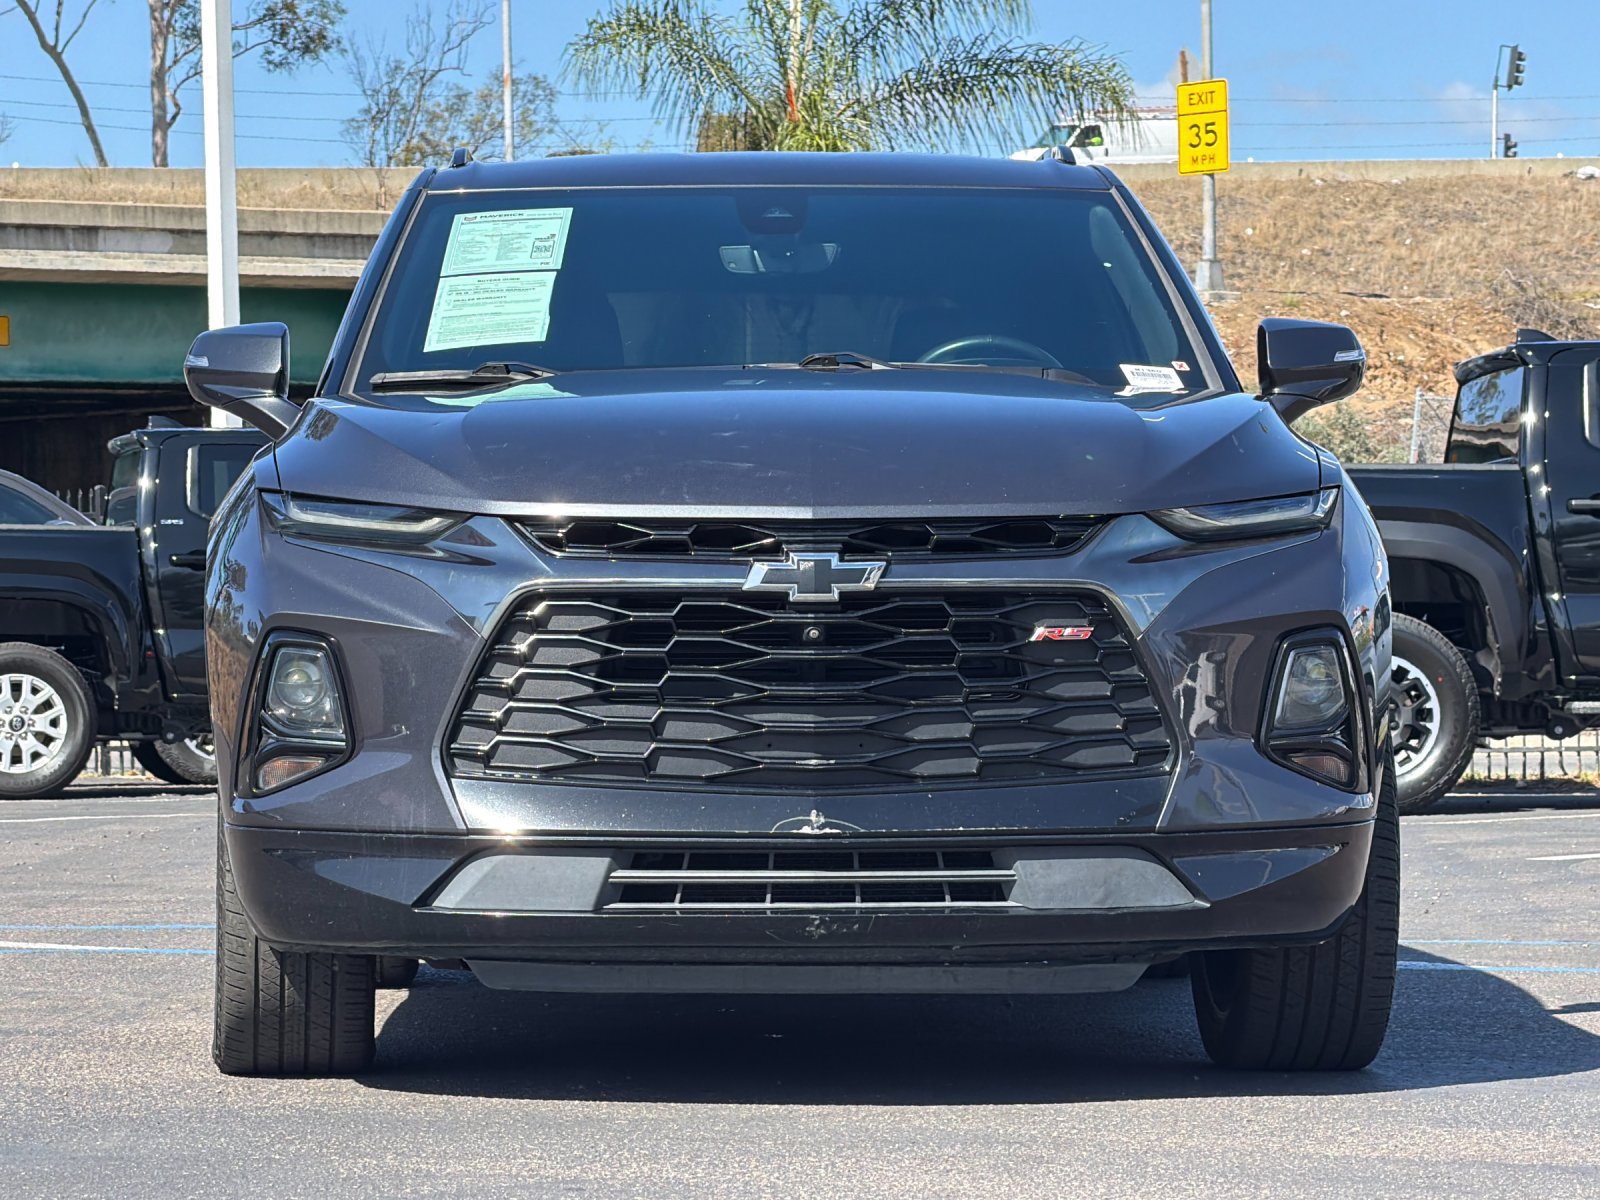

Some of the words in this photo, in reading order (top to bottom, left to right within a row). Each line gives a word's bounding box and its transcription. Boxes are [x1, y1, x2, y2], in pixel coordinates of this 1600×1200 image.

[1188, 91, 1215, 106] EXIT
[1188, 122, 1218, 148] 35
[1191, 154, 1216, 166] MPH
[1029, 626, 1095, 641] RS
